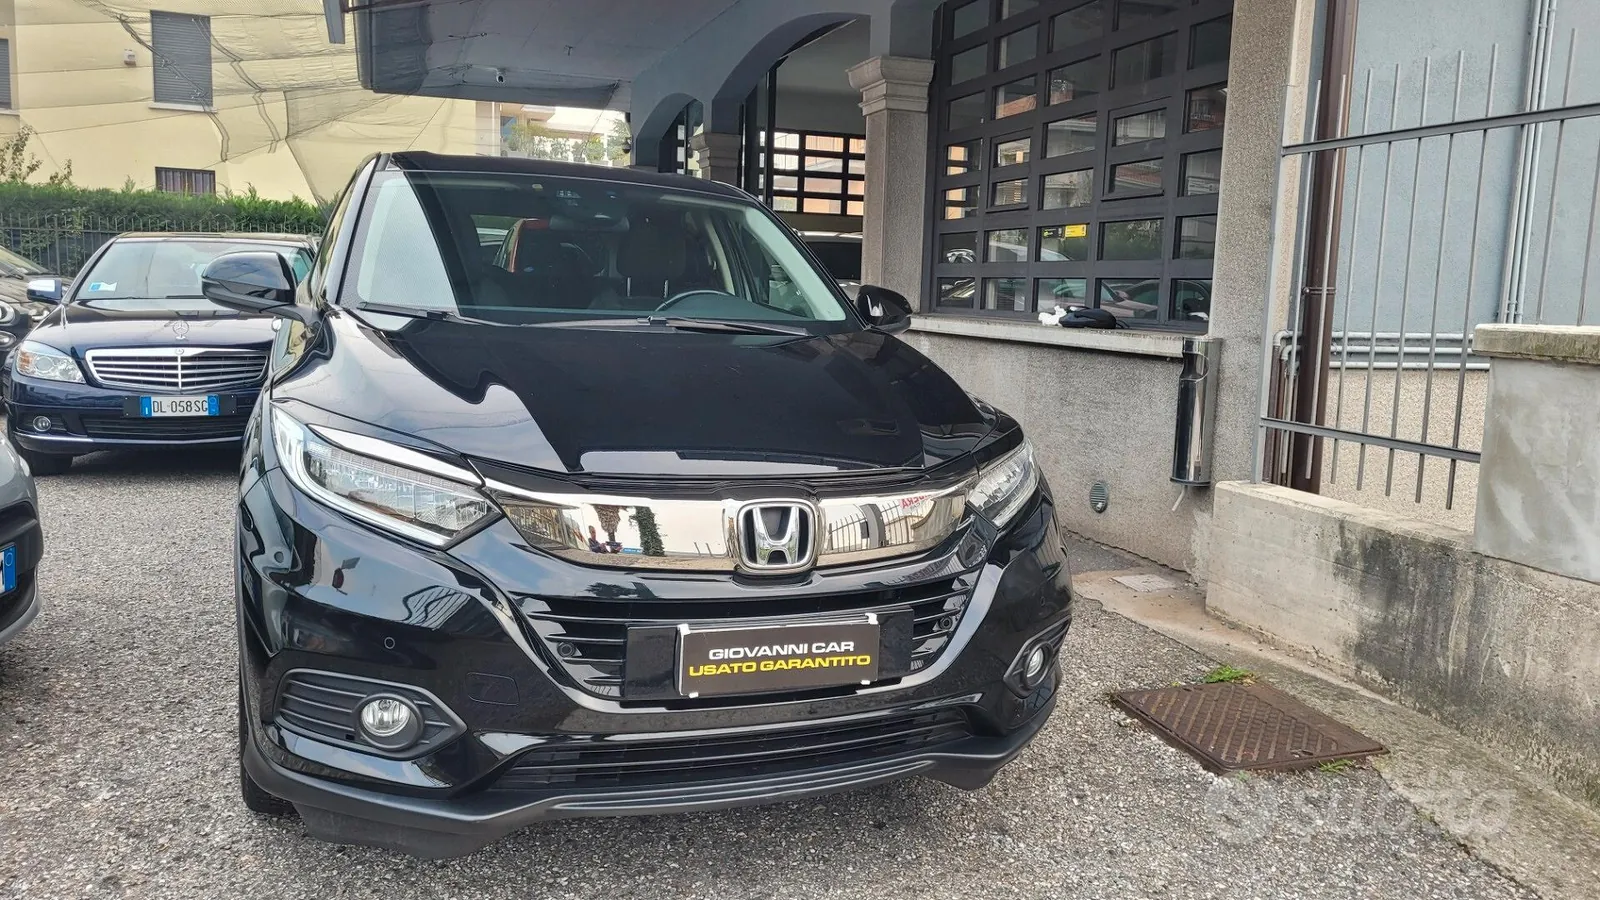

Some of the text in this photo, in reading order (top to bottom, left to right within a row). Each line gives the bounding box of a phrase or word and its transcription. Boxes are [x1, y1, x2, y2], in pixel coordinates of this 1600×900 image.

[708, 641, 855, 660] GIOVANNI CAR
[689, 655, 871, 676] USATO GARANTITO
